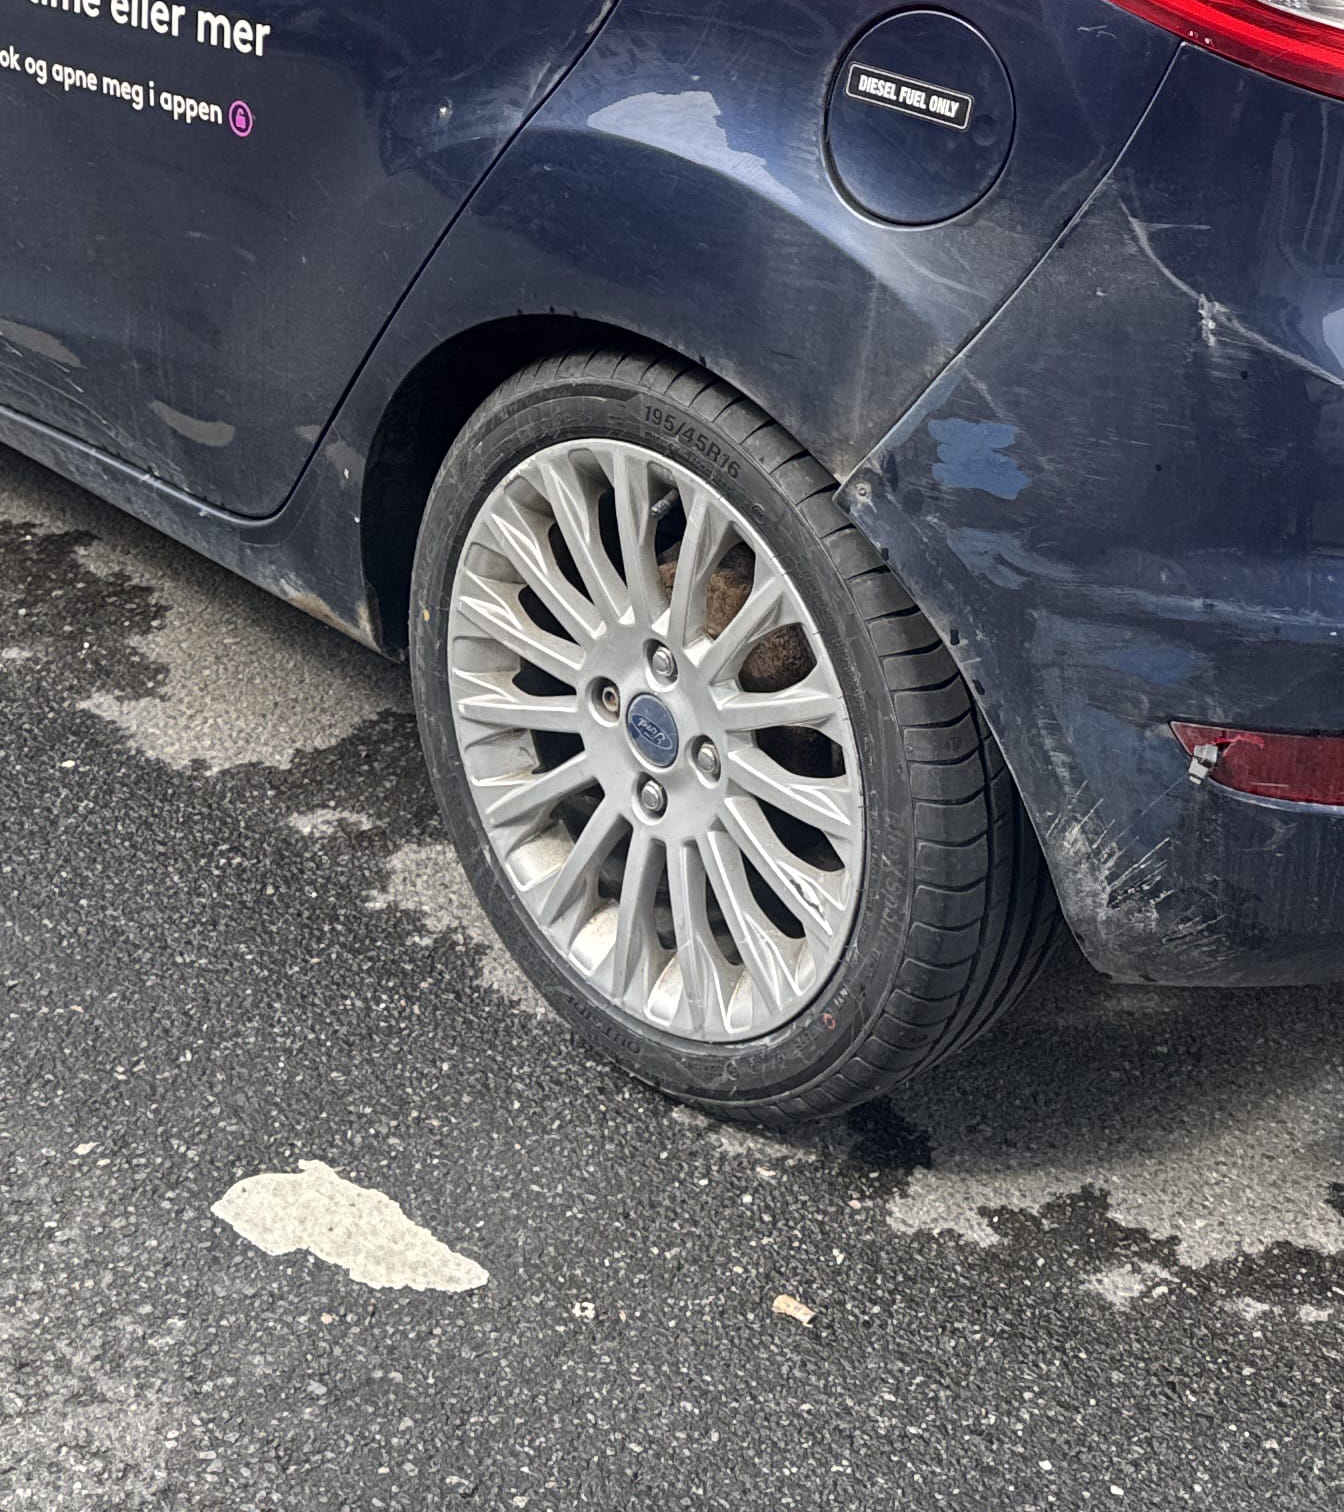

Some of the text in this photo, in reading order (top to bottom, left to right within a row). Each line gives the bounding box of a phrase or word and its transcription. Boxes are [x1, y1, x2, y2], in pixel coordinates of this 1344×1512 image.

[197, 10, 271, 57] mer
[24, 56, 48, 85] og
[52, 63, 98, 92] apne
[102, 76, 144, 111] meg
[148, 80, 155, 107] i
[159, 91, 223, 125] appen
[858, 74, 960, 118] DIESEL FUEL ONLY
[645, 405, 742, 479] 195/45R16
